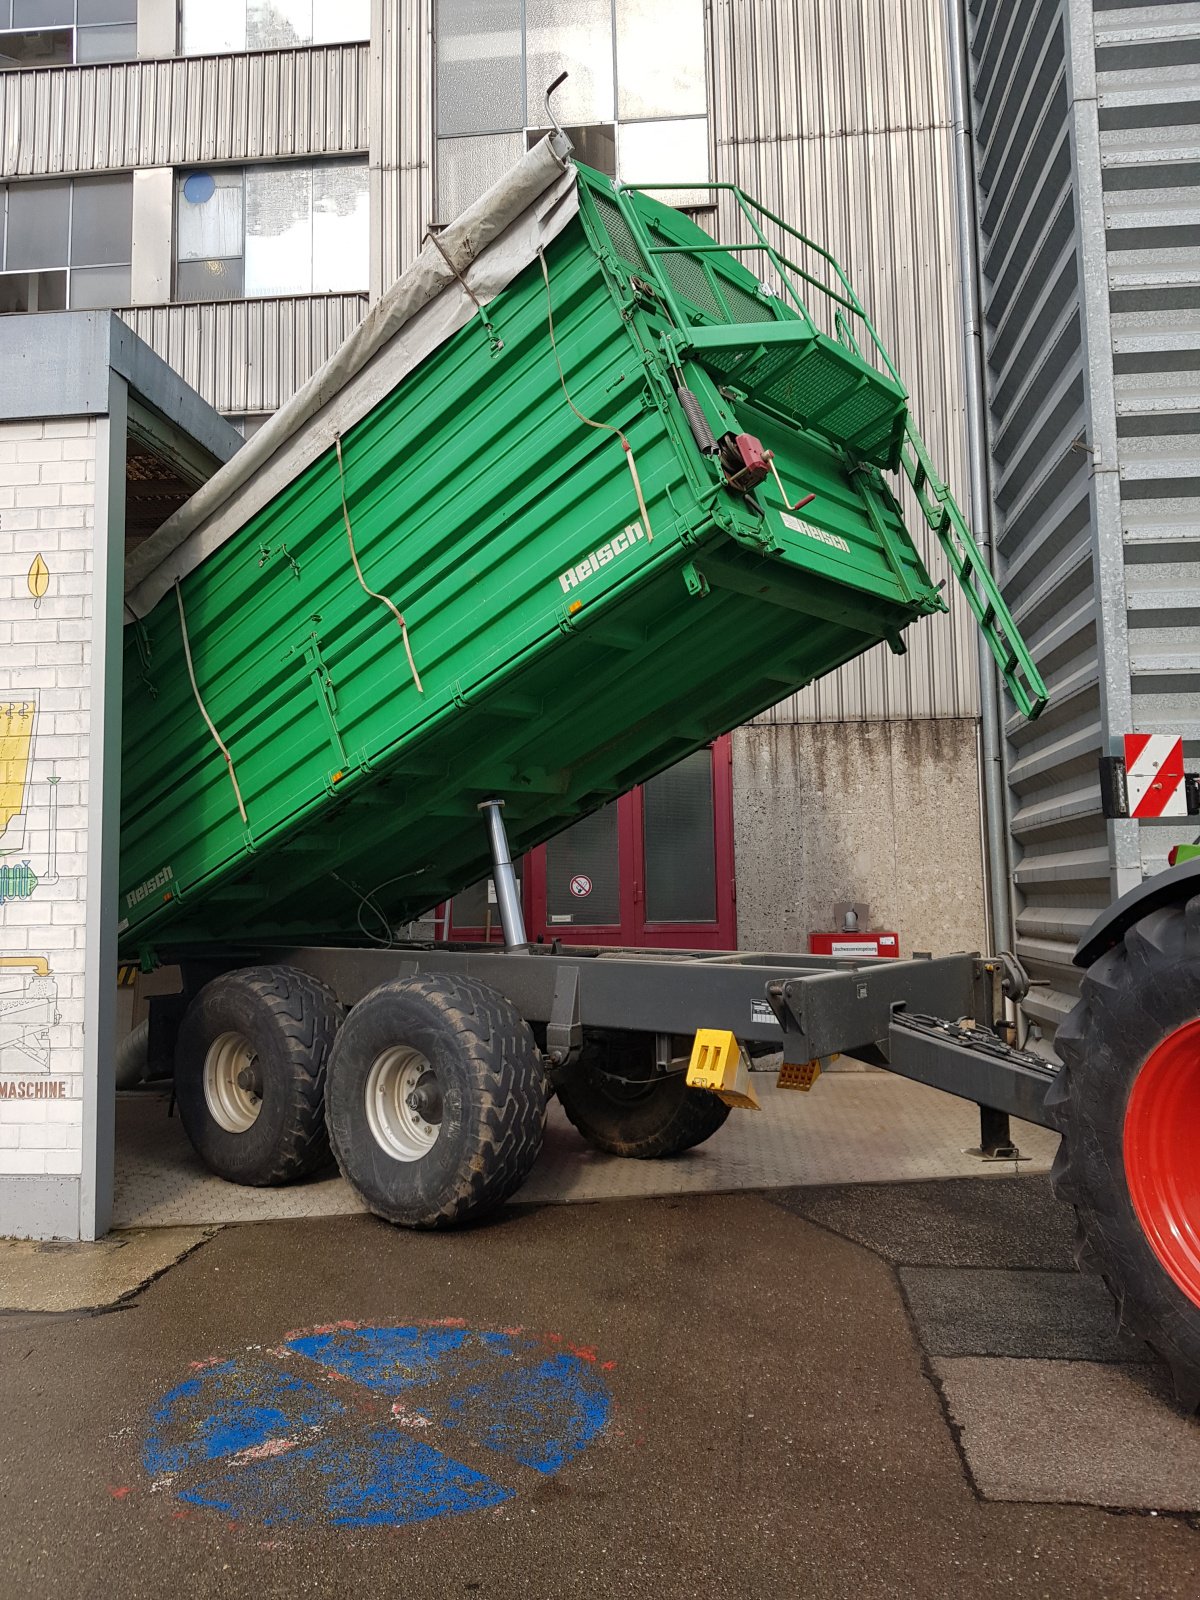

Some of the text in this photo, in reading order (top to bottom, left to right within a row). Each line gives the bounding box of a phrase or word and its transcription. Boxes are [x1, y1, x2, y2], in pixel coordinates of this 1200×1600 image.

[798, 519, 851, 554] Reisch
[558, 521, 645, 594] Reisch
[126, 865, 174, 909] Reisch
[0, 1081, 66, 1099] MASCHINE
